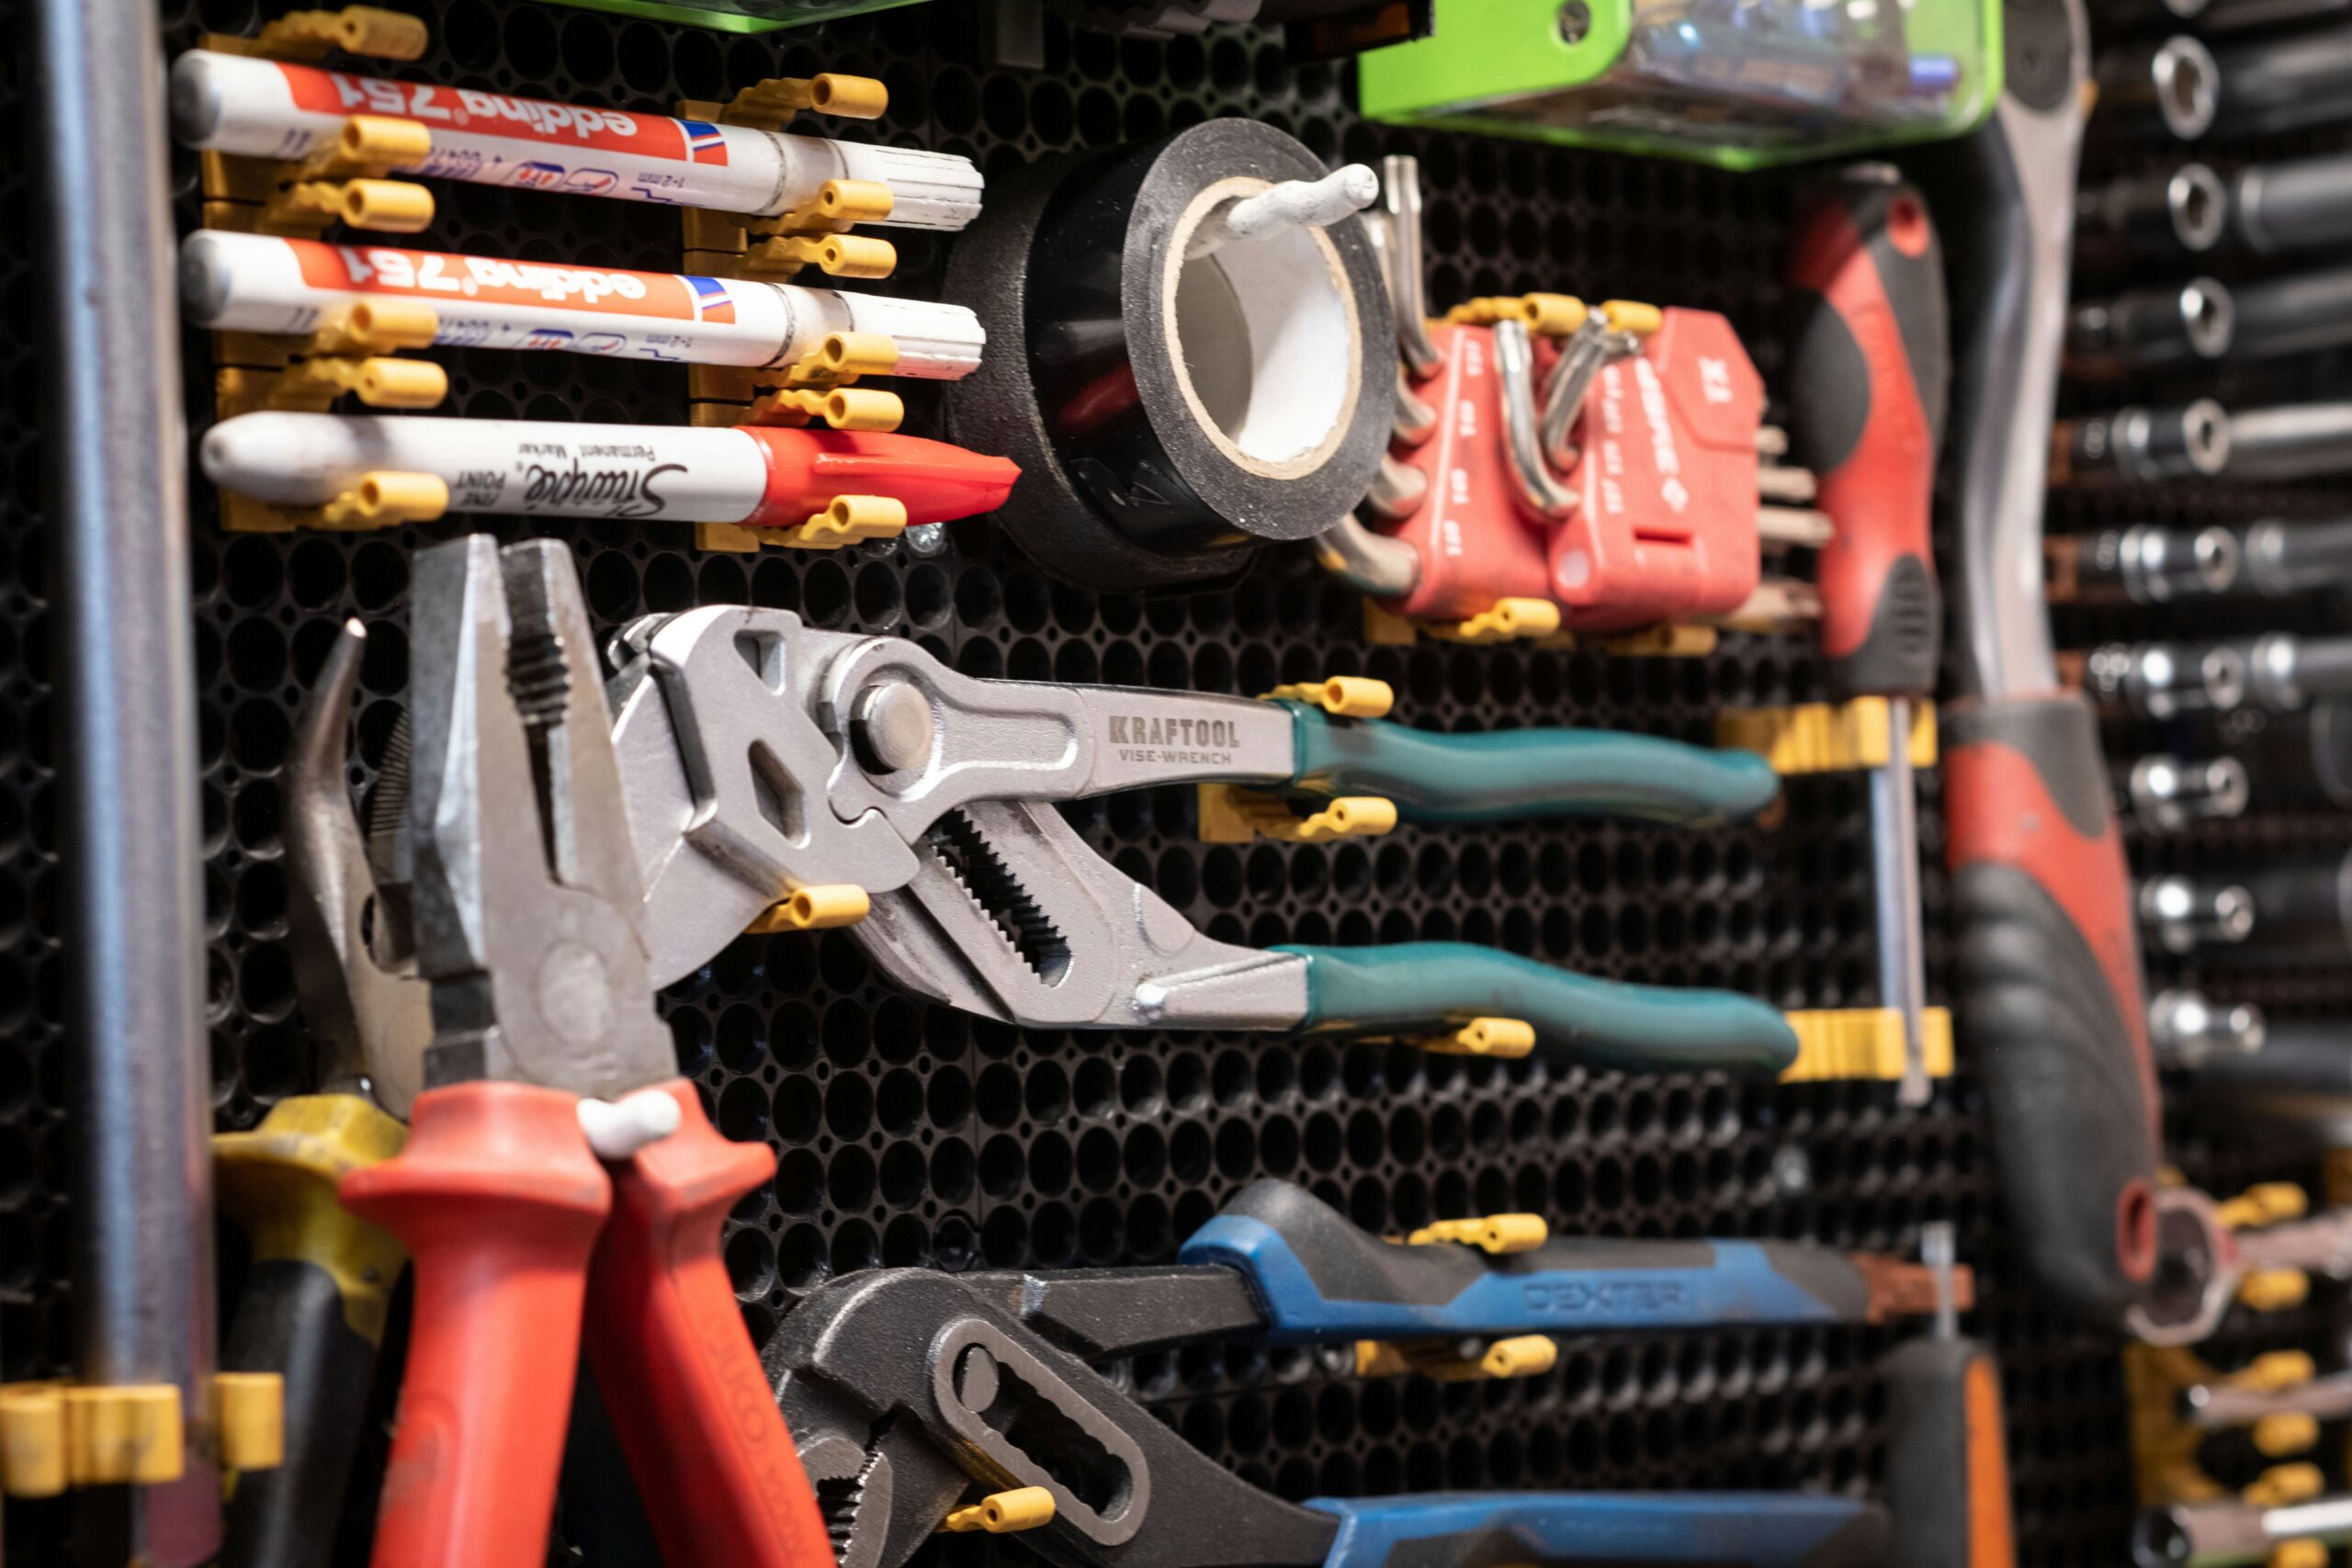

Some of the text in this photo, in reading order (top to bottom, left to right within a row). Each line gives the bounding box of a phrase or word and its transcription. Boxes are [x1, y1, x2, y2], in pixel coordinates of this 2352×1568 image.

[330, 73, 639, 138] edding 751
[337, 246, 647, 304] edding 751
[517, 443, 657, 461] Permanent Marker
[454, 470, 506, 491] POINT
[522, 457, 689, 518] Sharpie
[1108, 715, 1240, 749] KRAFTOOL
[1118, 748, 1232, 765] VISE-WRENCH
[1521, 1282, 1685, 1312] DEXTER
